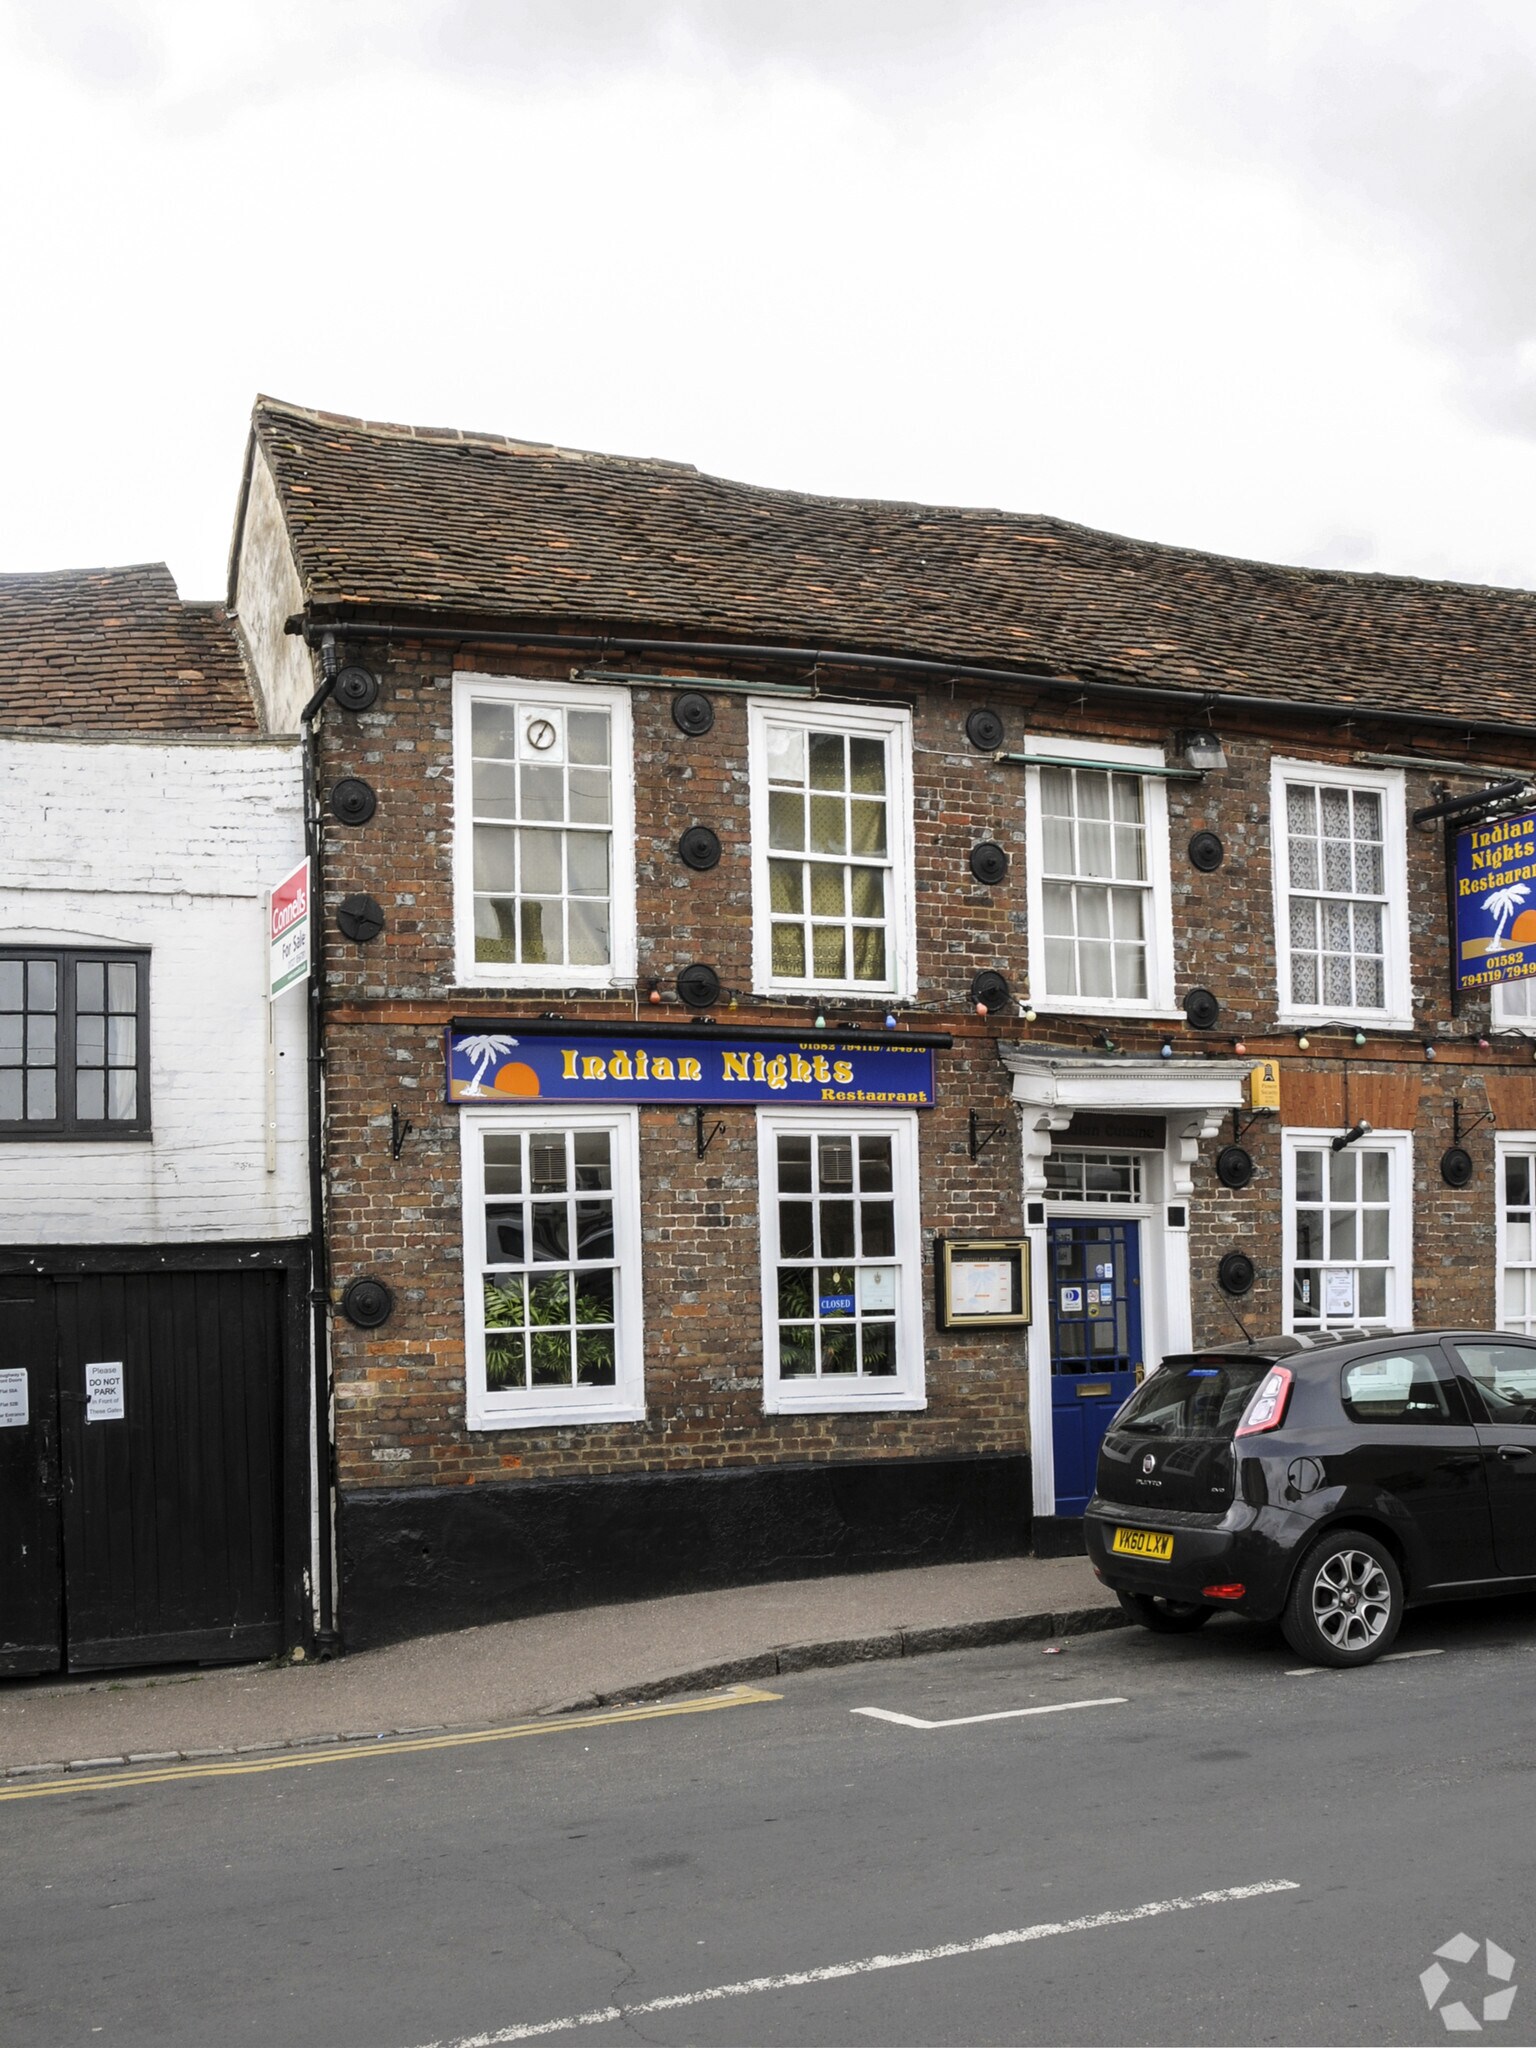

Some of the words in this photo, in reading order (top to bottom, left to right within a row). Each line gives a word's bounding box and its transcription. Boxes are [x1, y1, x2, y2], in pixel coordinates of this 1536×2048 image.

[1471, 818, 1535, 849] Indian
[1471, 841, 1535, 870] Nights
[272, 888, 306, 934] Connells
[282, 941, 292, 960] For
[293, 929, 306, 951] Sale
[1486, 952, 1524, 969] 01582
[561, 1049, 702, 1081] Indian
[722, 1051, 854, 1090] Nights
[821, 1088, 928, 1102] Restaurant
[821, 1299, 851, 1309] CLOSED
[89, 1379, 102, 1387] DO
[103, 1378, 120, 1386] NOT
[94, 1387, 117, 1396] PARK
[1119, 1530, 1145, 1551] VK60
[1146, 1533, 1170, 1554] LXW
